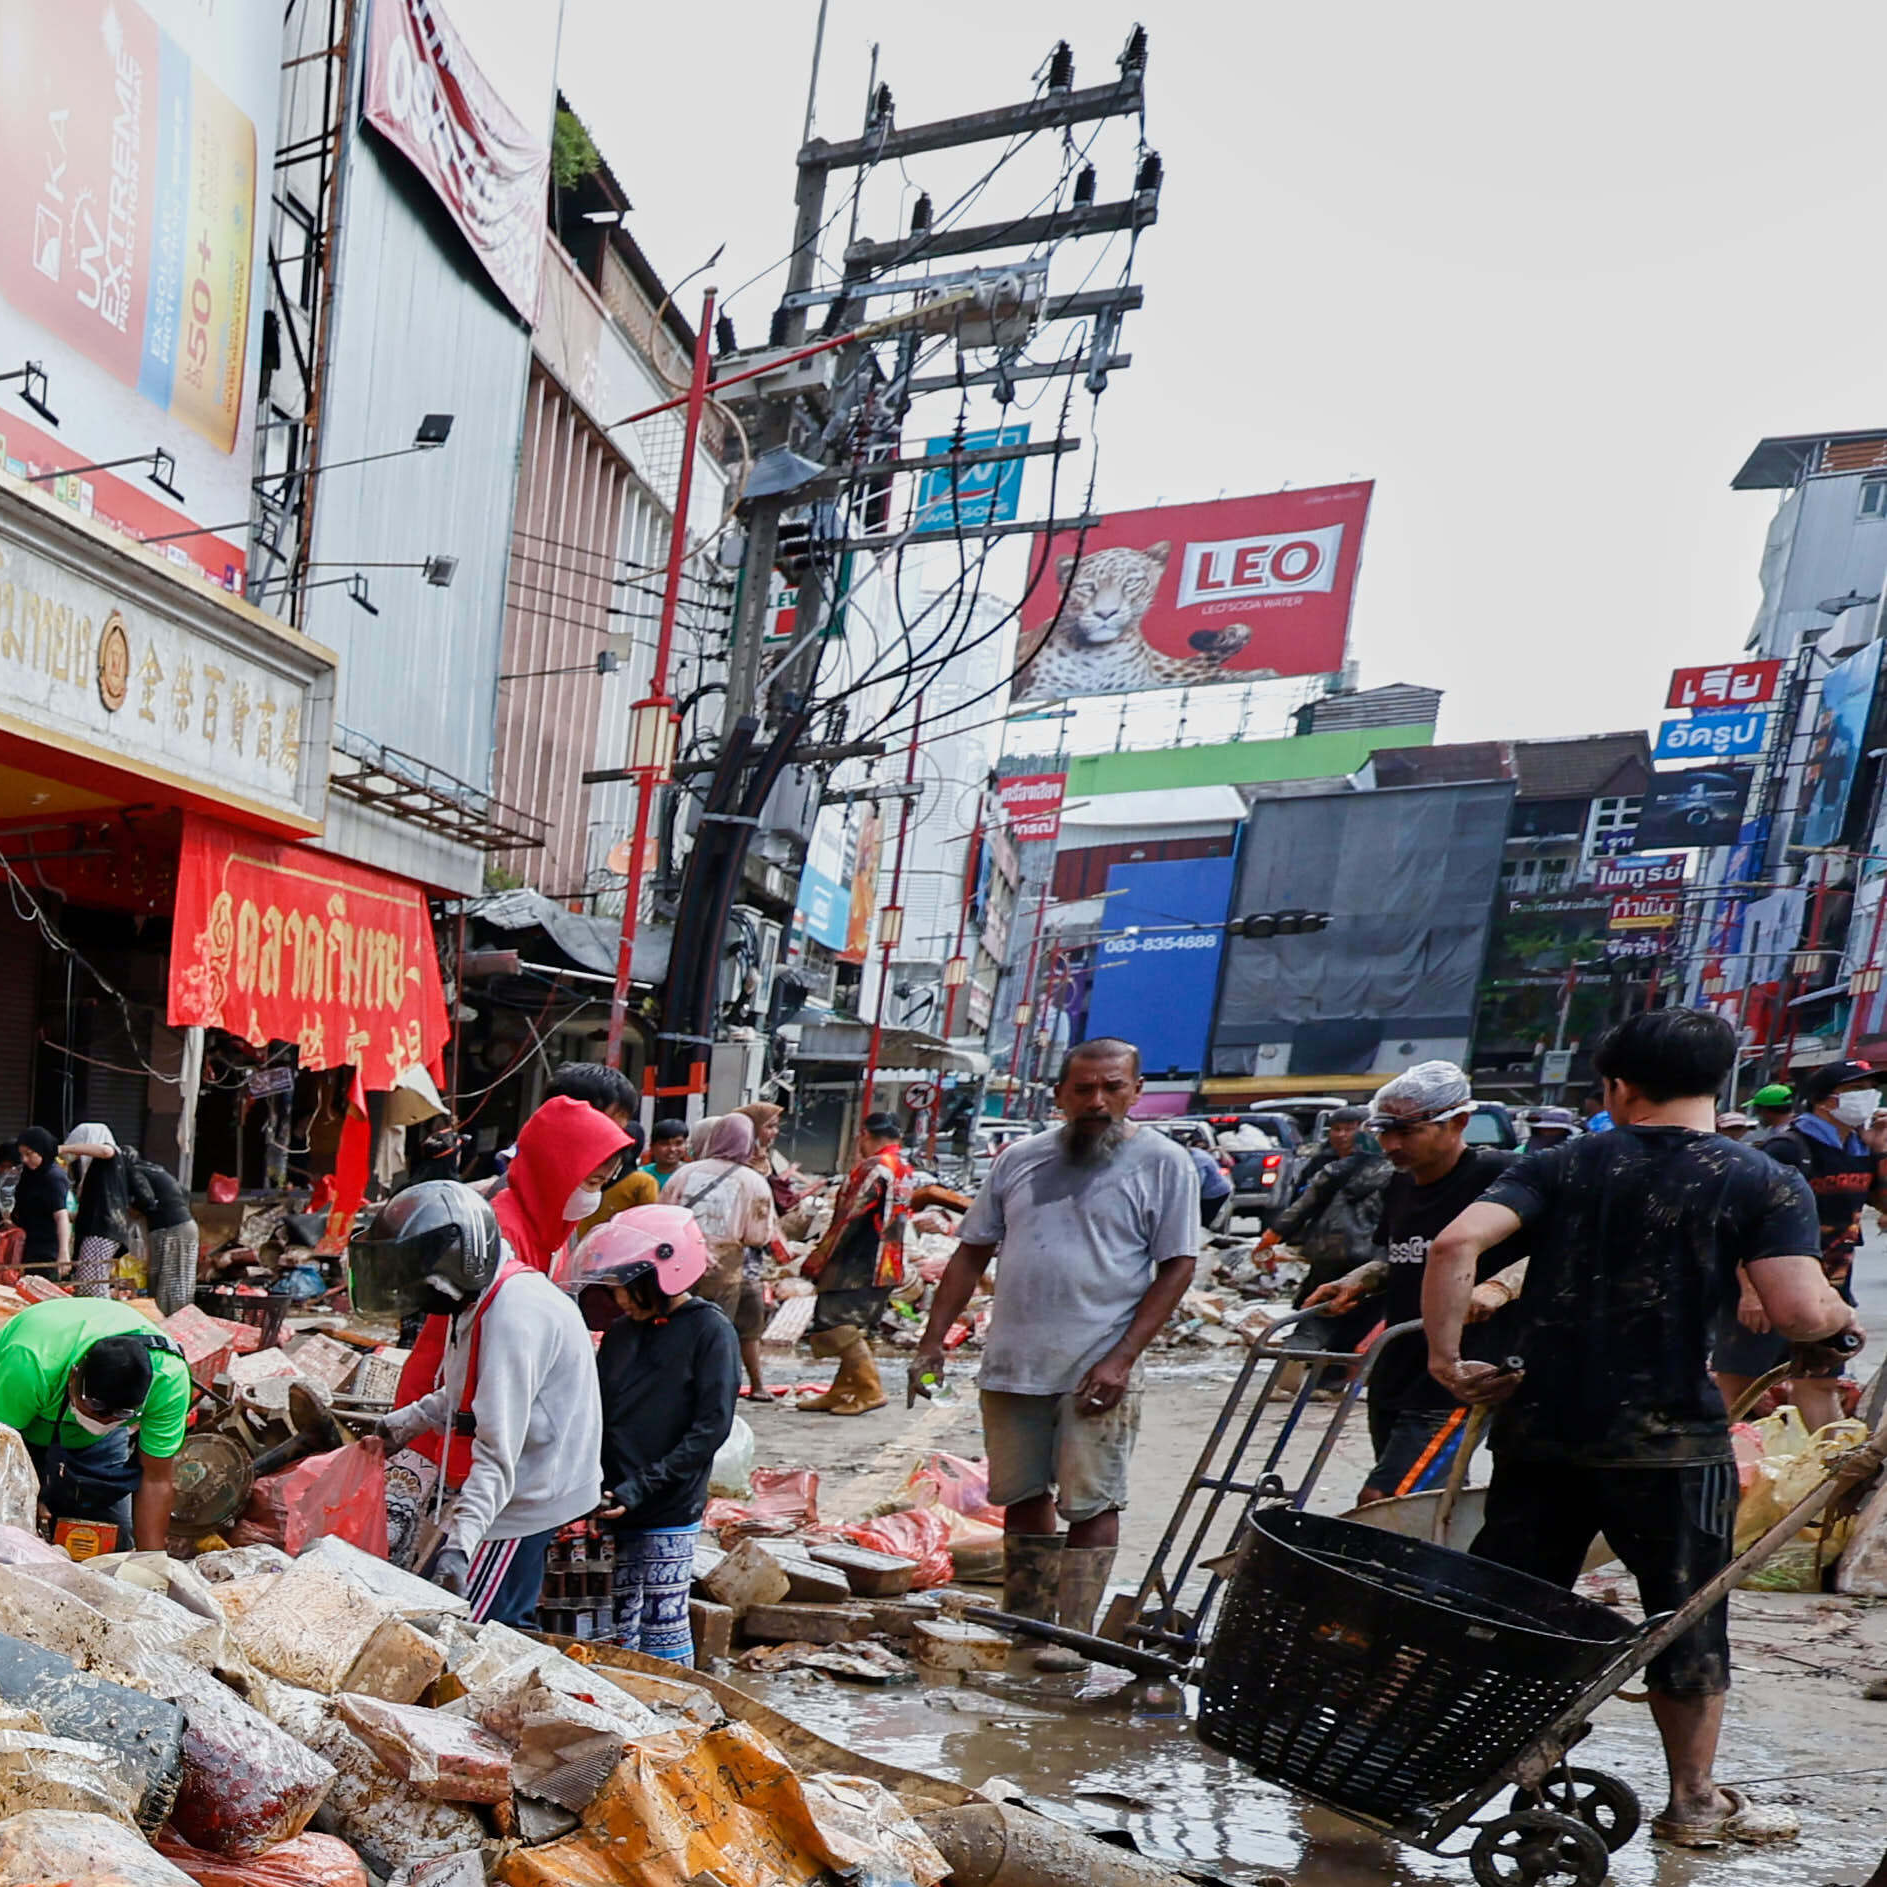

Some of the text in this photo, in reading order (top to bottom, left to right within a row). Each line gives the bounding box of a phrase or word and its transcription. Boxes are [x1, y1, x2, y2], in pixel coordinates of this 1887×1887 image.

[100, 48, 137, 328] EXTREME
[1195, 540, 1322, 592] LEO
[1666, 717, 1758, 753] อัดรูป
[236, 893, 422, 1014] ตลาดกิมหย
